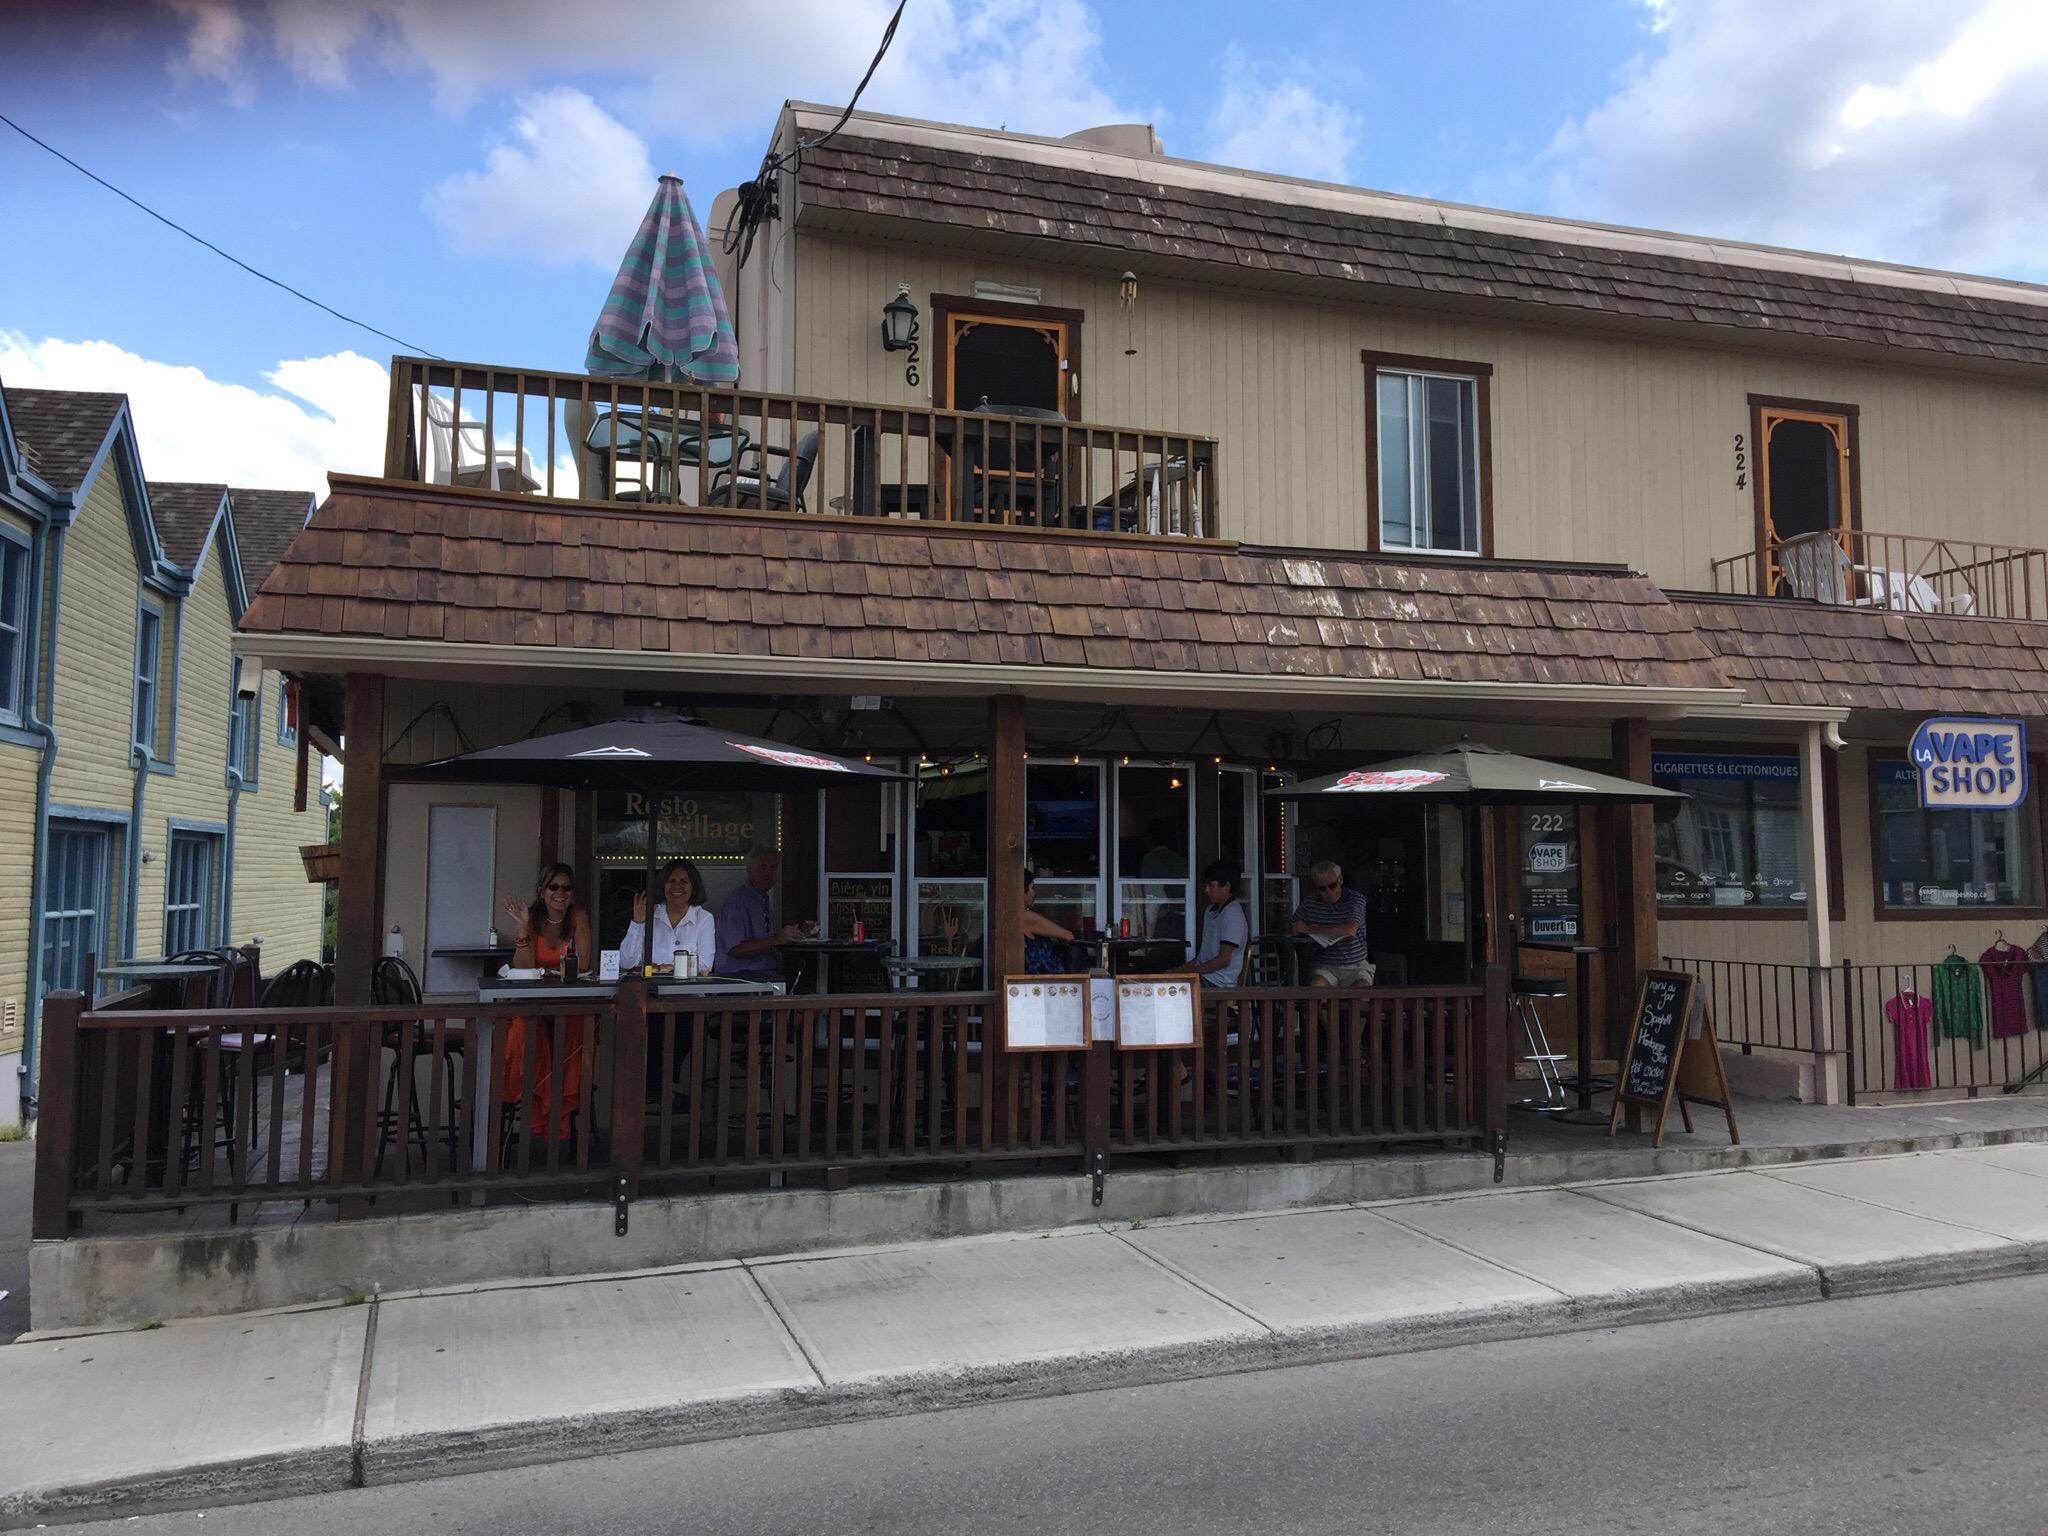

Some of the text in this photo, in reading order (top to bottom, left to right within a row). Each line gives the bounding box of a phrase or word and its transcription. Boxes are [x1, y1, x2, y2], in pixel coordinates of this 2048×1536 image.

[906, 321, 920, 387] 226
[1734, 434, 1747, 491] 224
[1915, 748, 1932, 762] LA
[1930, 732, 2015, 765] VAPE
[1653, 761, 1799, 777] CIGARETTES ÉLECTRONIQUES
[1931, 766, 2016, 794] SHOP
[1531, 814, 1564, 831] 222
[1536, 848, 1563, 858] VAPE
[1536, 859, 1564, 868] SHOP
[1534, 920, 1565, 932] Ouvert
